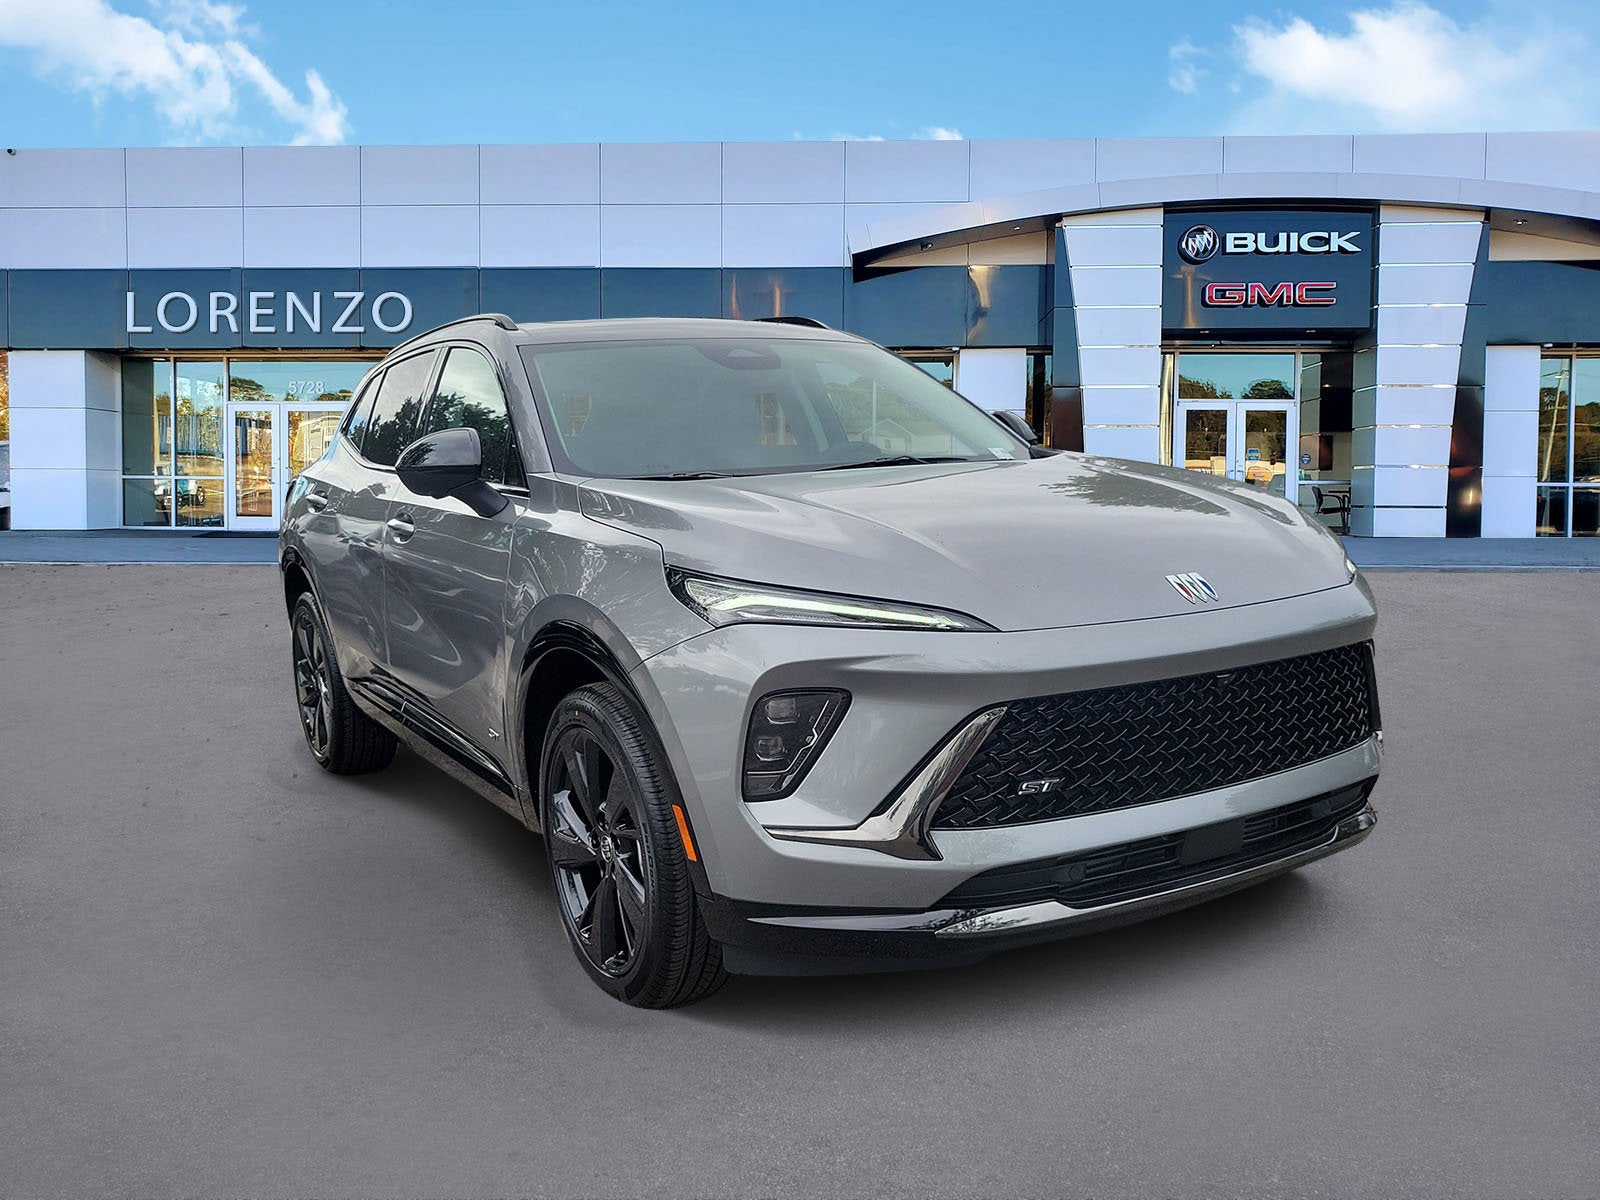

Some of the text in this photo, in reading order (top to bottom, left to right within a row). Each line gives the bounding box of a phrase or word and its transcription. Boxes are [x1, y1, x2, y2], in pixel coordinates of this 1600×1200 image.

[1225, 231, 1362, 253] BUICK
[1205, 282, 1337, 305] GMC
[126, 291, 414, 334] LORENZO
[288, 380, 325, 394] 5728
